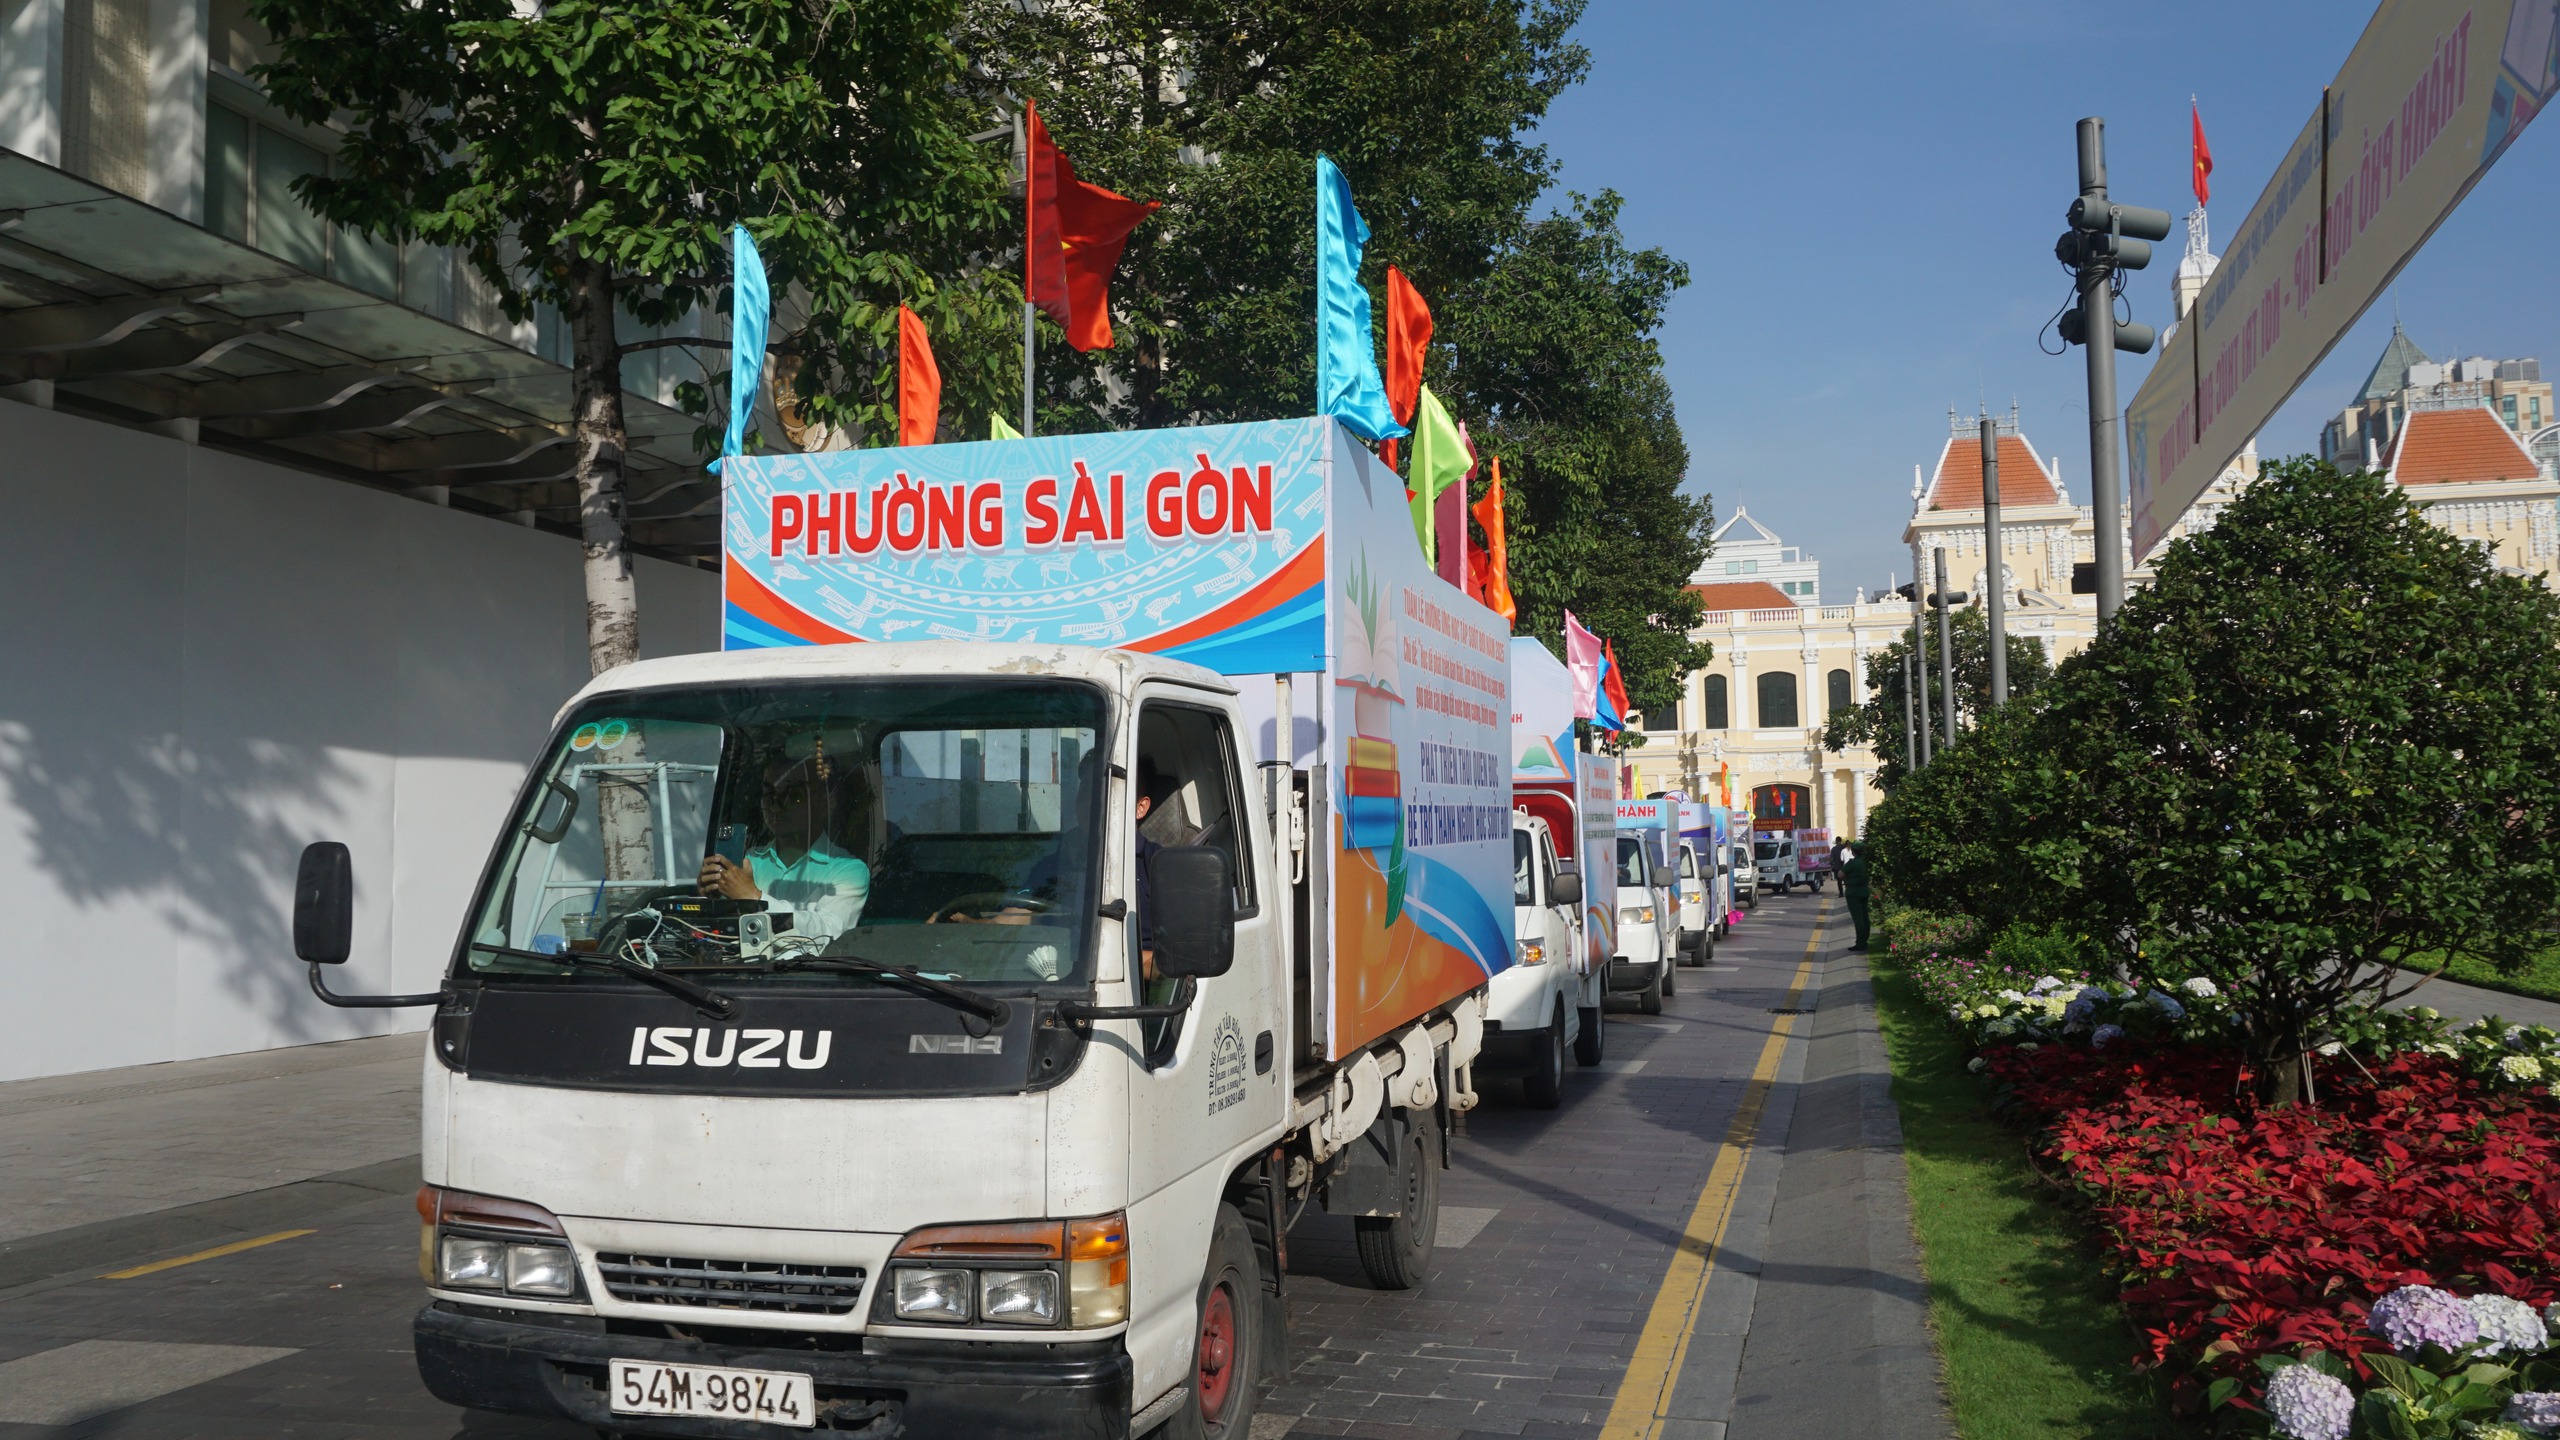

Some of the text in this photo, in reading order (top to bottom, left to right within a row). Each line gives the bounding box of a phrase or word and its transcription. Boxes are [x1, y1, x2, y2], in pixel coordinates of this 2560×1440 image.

[769, 453, 1273, 559] PHƯỜNG SÀI GÒN
[1420, 734, 1438, 784] PHÁT
[1439, 731, 1458, 785] TRIỂN
[1458, 741, 1472, 786] THÓI
[1473, 751, 1488, 790] QUEN
[1408, 787, 1418, 848] ĐỂ
[1419, 791, 1433, 847] TRỞ
[1434, 796, 1456, 845] THÀNH
[1457, 796, 1475, 843] NGƯỜI
[1475, 805, 1486, 849] HỌC
[1487, 794, 1499, 840] SUỐT
[629, 1026, 833, 1070] ISUZU
[908, 1034, 1003, 1055] NHR
[1209, 1051, 1217, 1099] TRUNG
[1214, 1021, 1223, 1049] TÂM
[1208, 1101, 1217, 1117] ĐT:
[622, 1366, 800, 1420] 54M-9844
